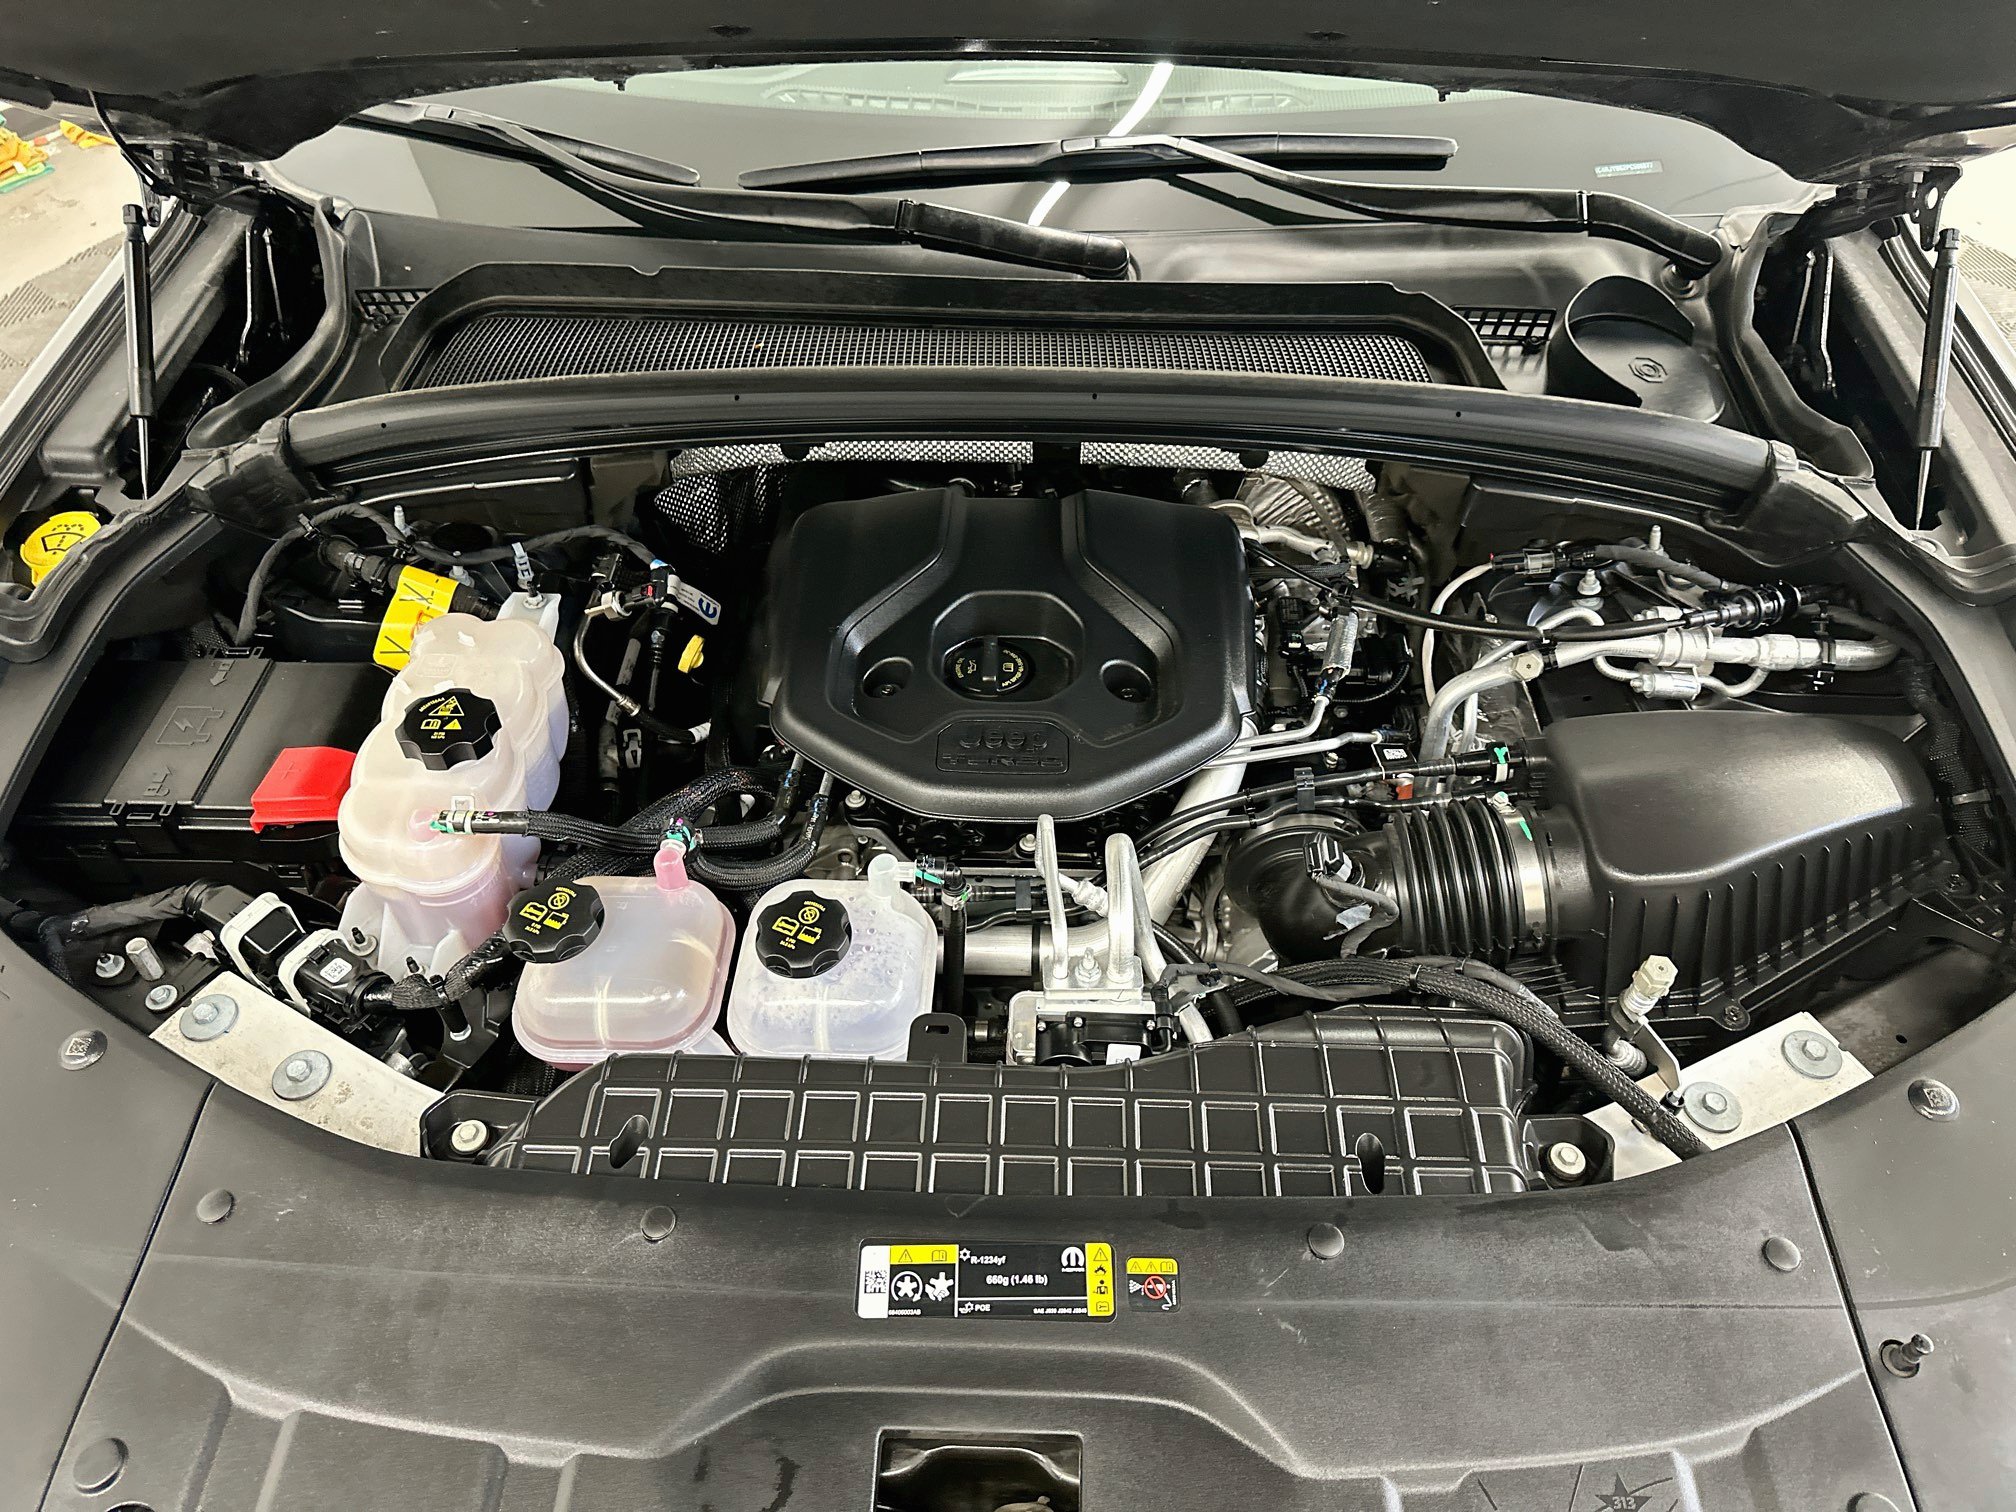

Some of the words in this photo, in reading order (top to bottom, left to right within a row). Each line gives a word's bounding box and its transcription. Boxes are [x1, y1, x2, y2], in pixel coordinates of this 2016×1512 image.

[970, 1255, 1007, 1266] R-1234yf
[1035, 1274, 1048, 1286] lb)
[974, 1303, 991, 1312] POE
[1612, 1496, 1637, 1510] 313
